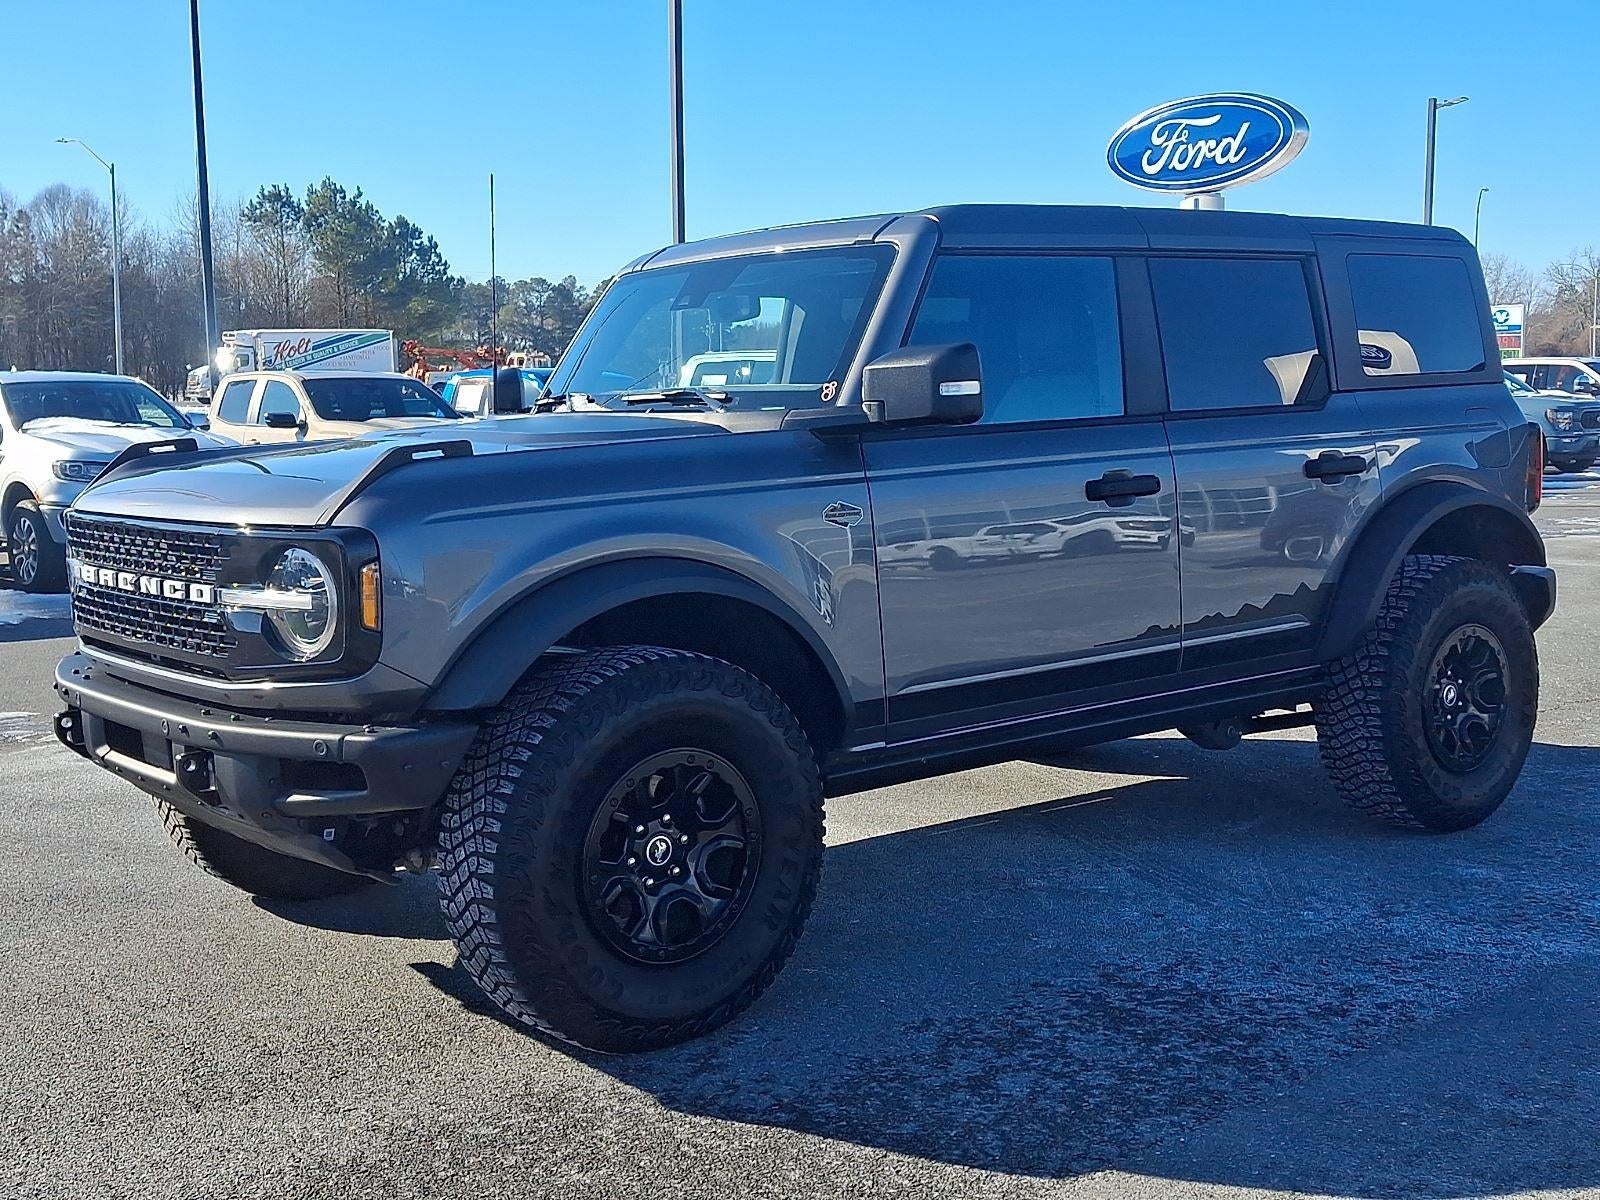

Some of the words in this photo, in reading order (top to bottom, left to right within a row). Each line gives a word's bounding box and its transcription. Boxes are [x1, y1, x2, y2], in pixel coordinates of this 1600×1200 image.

[1142, 114, 1250, 175] Ford
[266, 337, 312, 367] Holt
[286, 357, 306, 368] LEADER
[313, 348, 333, 360] QUALITY
[339, 340, 359, 351] SERVICE
[81, 566, 214, 604] BRONCO
